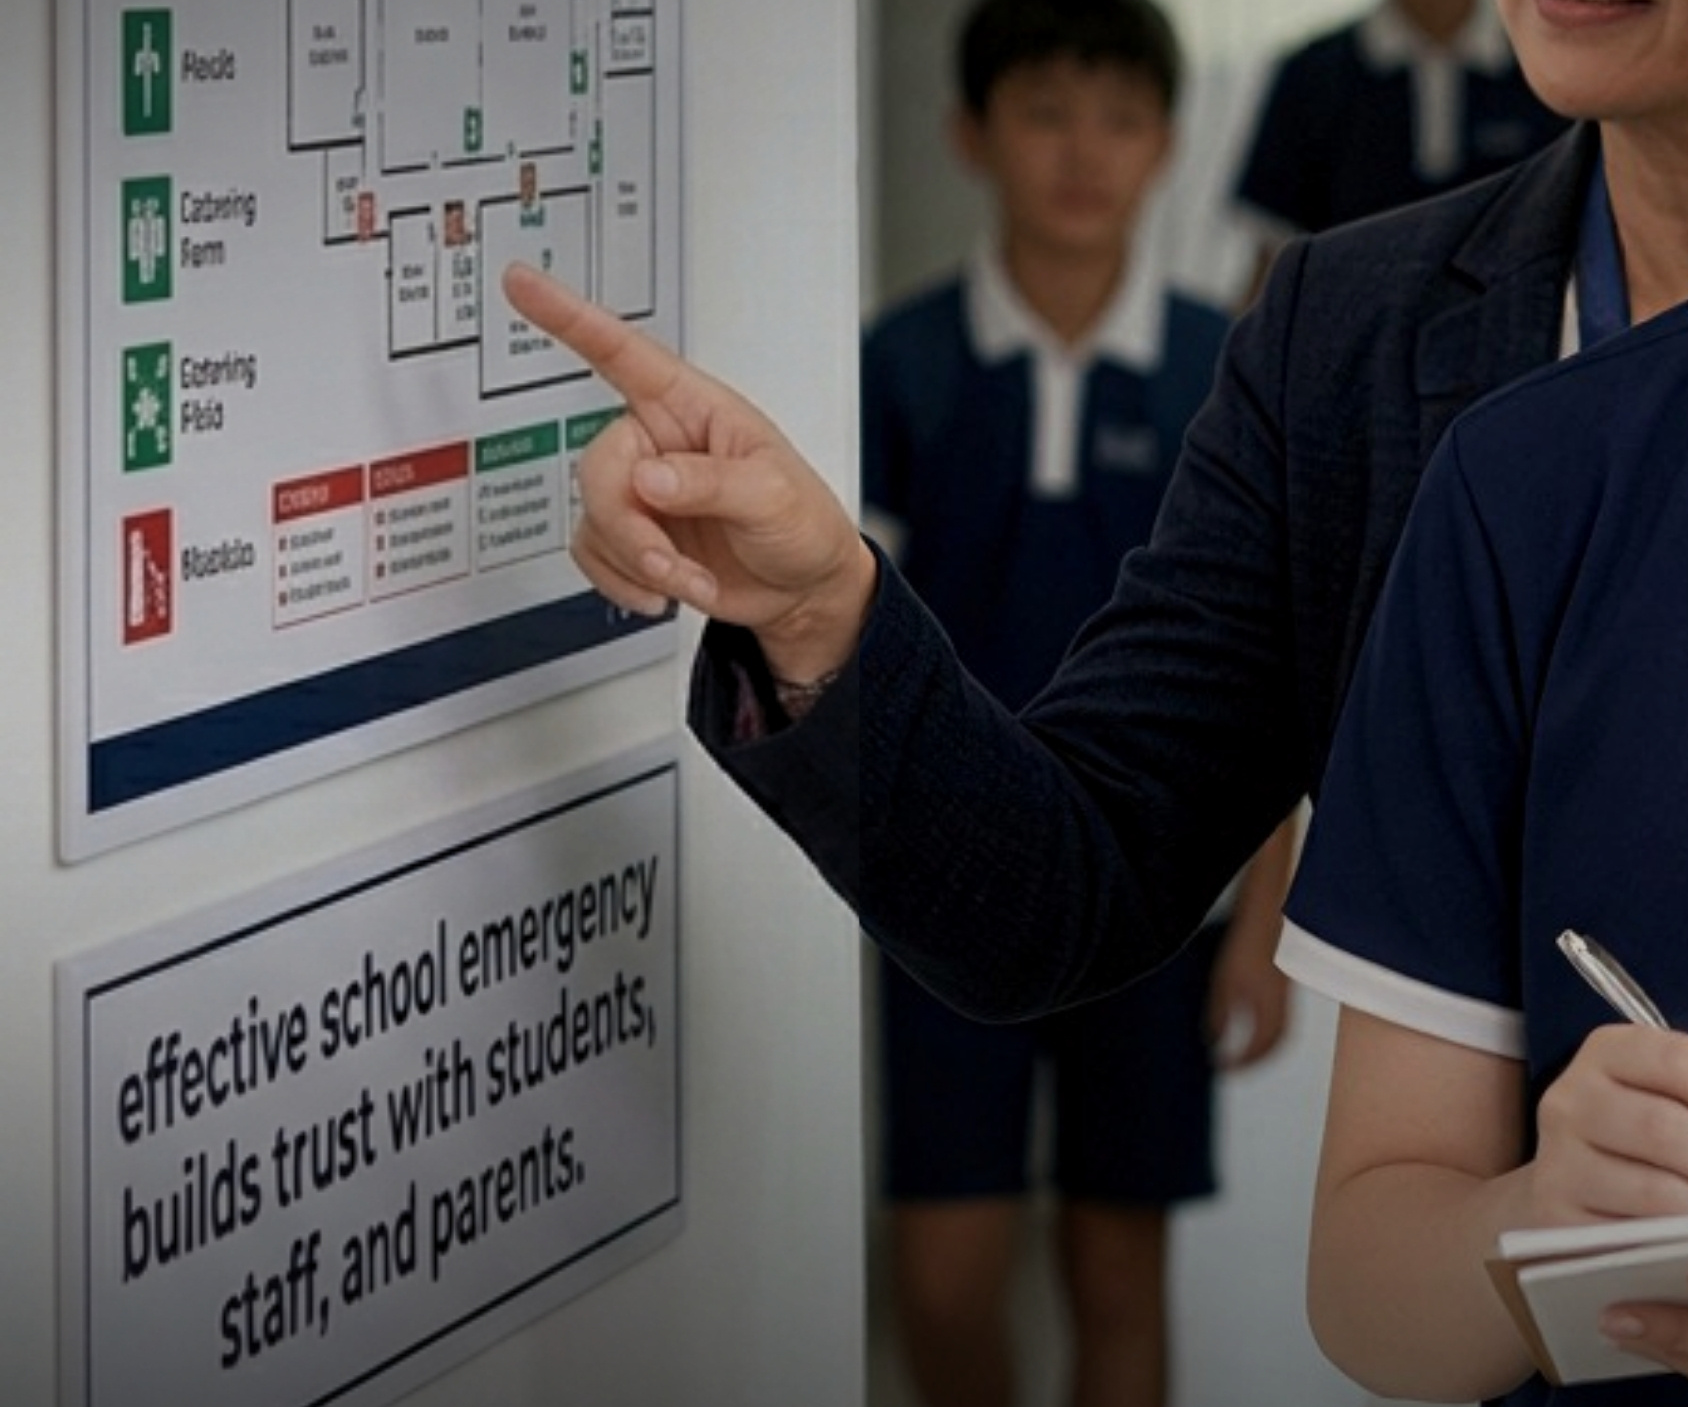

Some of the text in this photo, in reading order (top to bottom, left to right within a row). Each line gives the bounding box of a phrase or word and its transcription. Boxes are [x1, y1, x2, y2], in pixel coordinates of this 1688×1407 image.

[118, 855, 658, 1143] effective school emergency
[123, 971, 656, 1282] builds trust with students,
[221, 1125, 585, 1368] staff, and parents.
